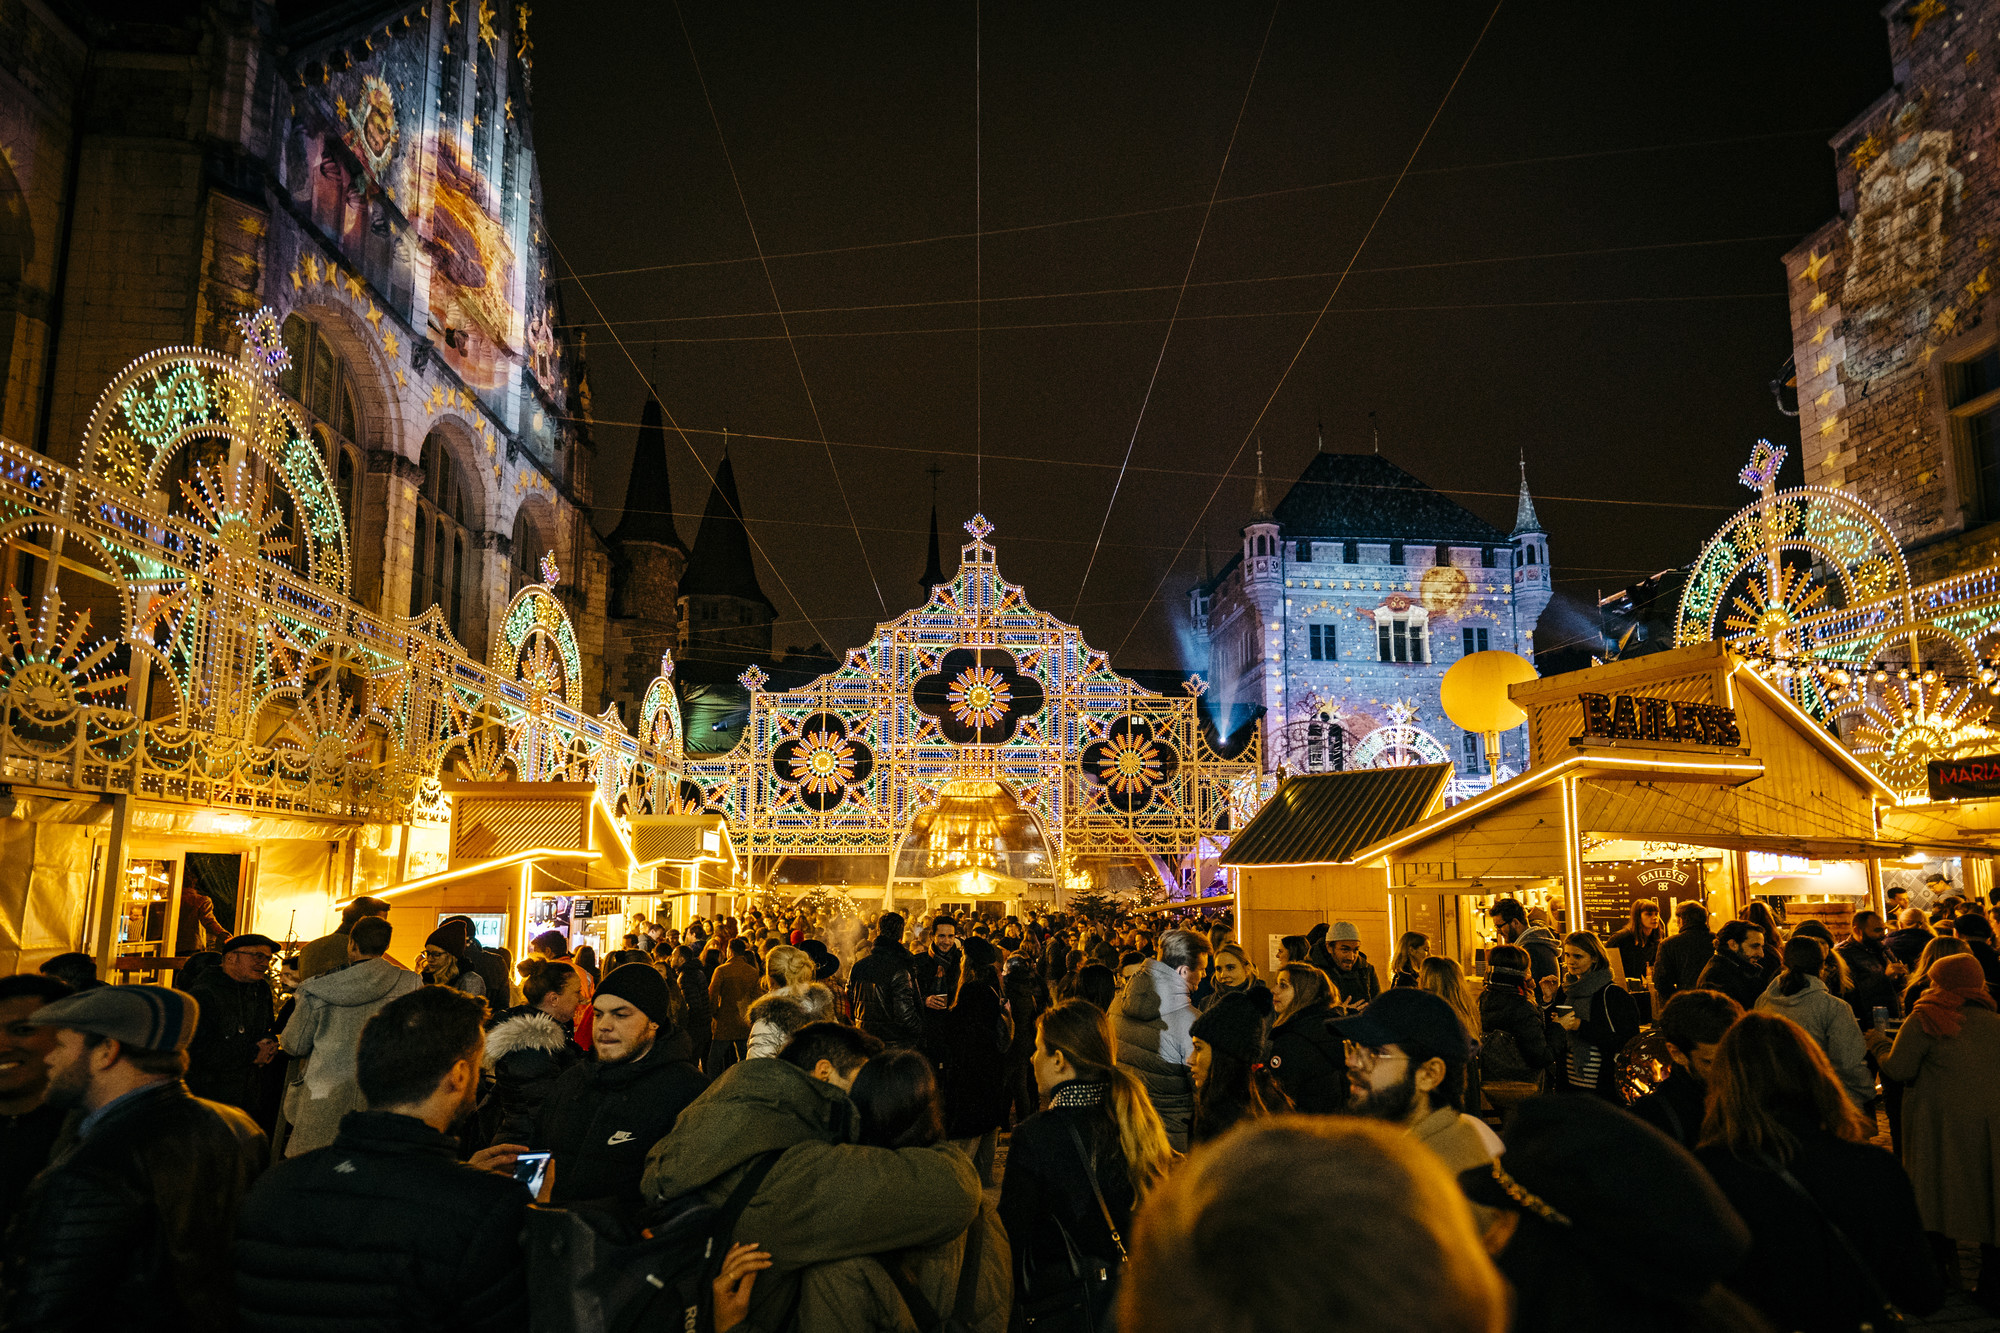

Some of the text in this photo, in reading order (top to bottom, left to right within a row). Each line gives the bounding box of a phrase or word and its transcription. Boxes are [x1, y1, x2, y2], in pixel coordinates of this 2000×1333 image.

[1579, 693, 1741, 747] BAILEYS
[1939, 762, 2000, 785] MARIA
[1640, 870, 1686, 883] BAILEYS
